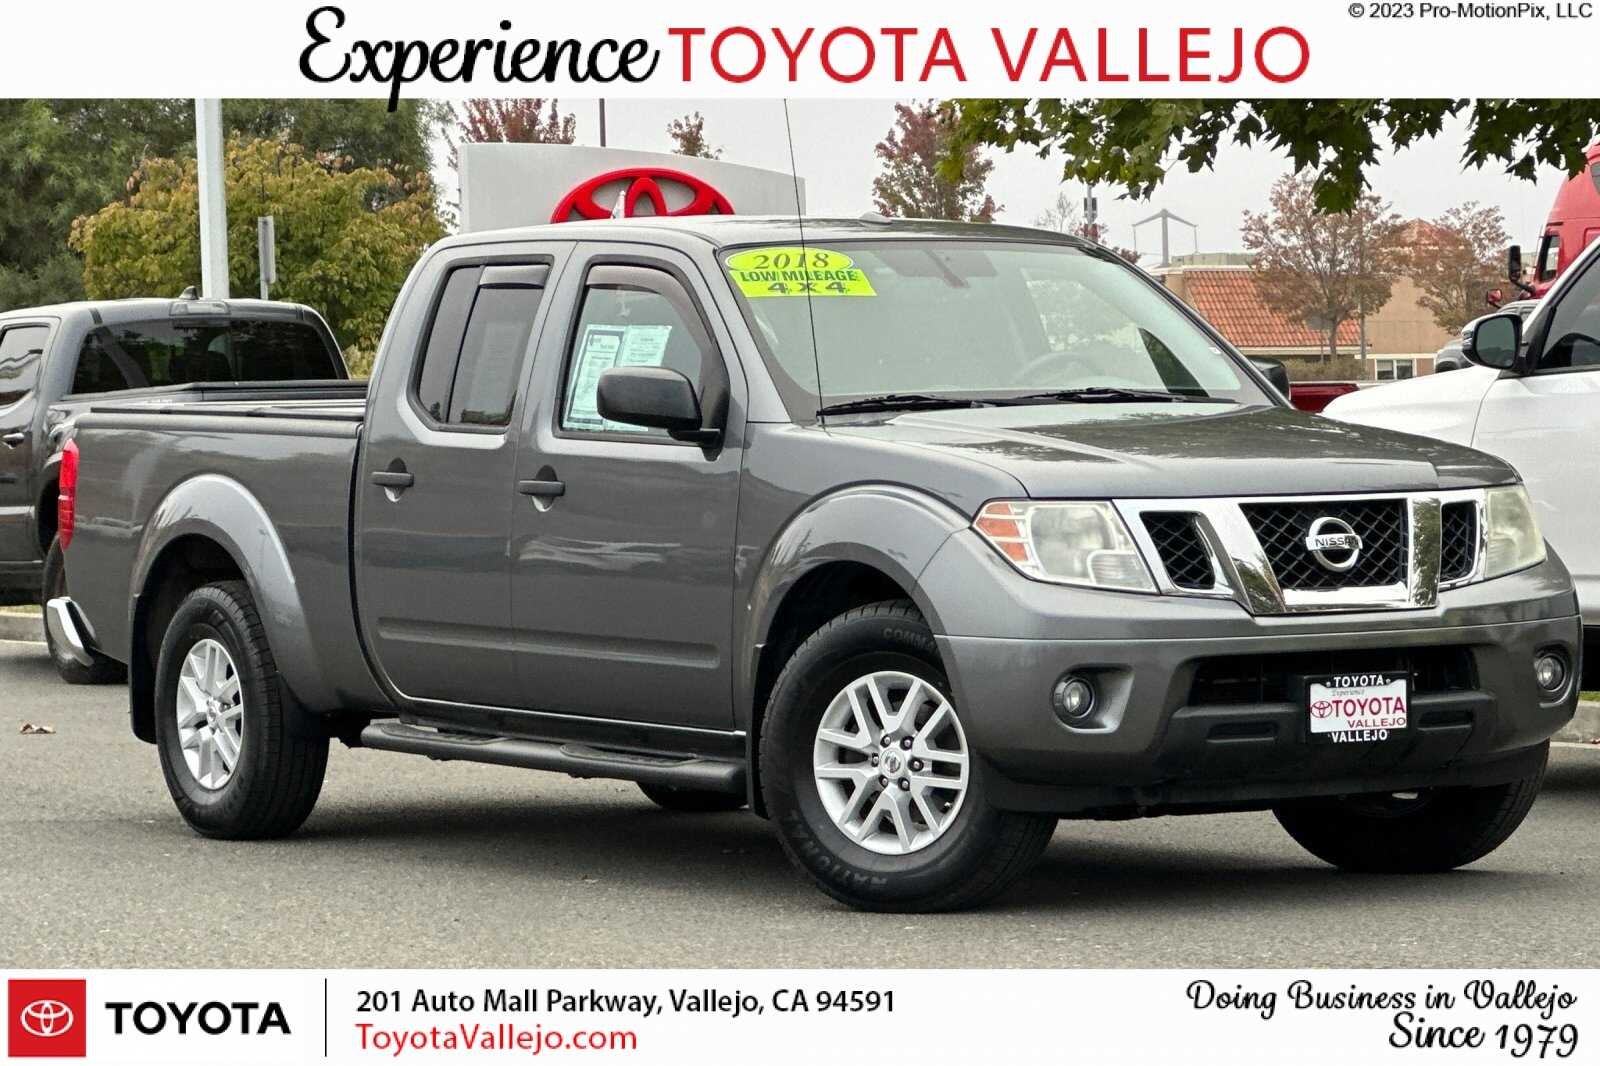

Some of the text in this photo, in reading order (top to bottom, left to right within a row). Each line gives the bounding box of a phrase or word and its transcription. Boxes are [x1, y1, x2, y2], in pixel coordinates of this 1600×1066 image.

[752, 252, 831, 270] 2018
[740, 270, 857, 282] LOW MILEAGE
[1333, 674, 1384, 688] TOYOTA
[1331, 696, 1406, 718] TOYOTA
[1347, 717, 1406, 729] VALLEJO
[1331, 729, 1388, 743] VALLEJO
